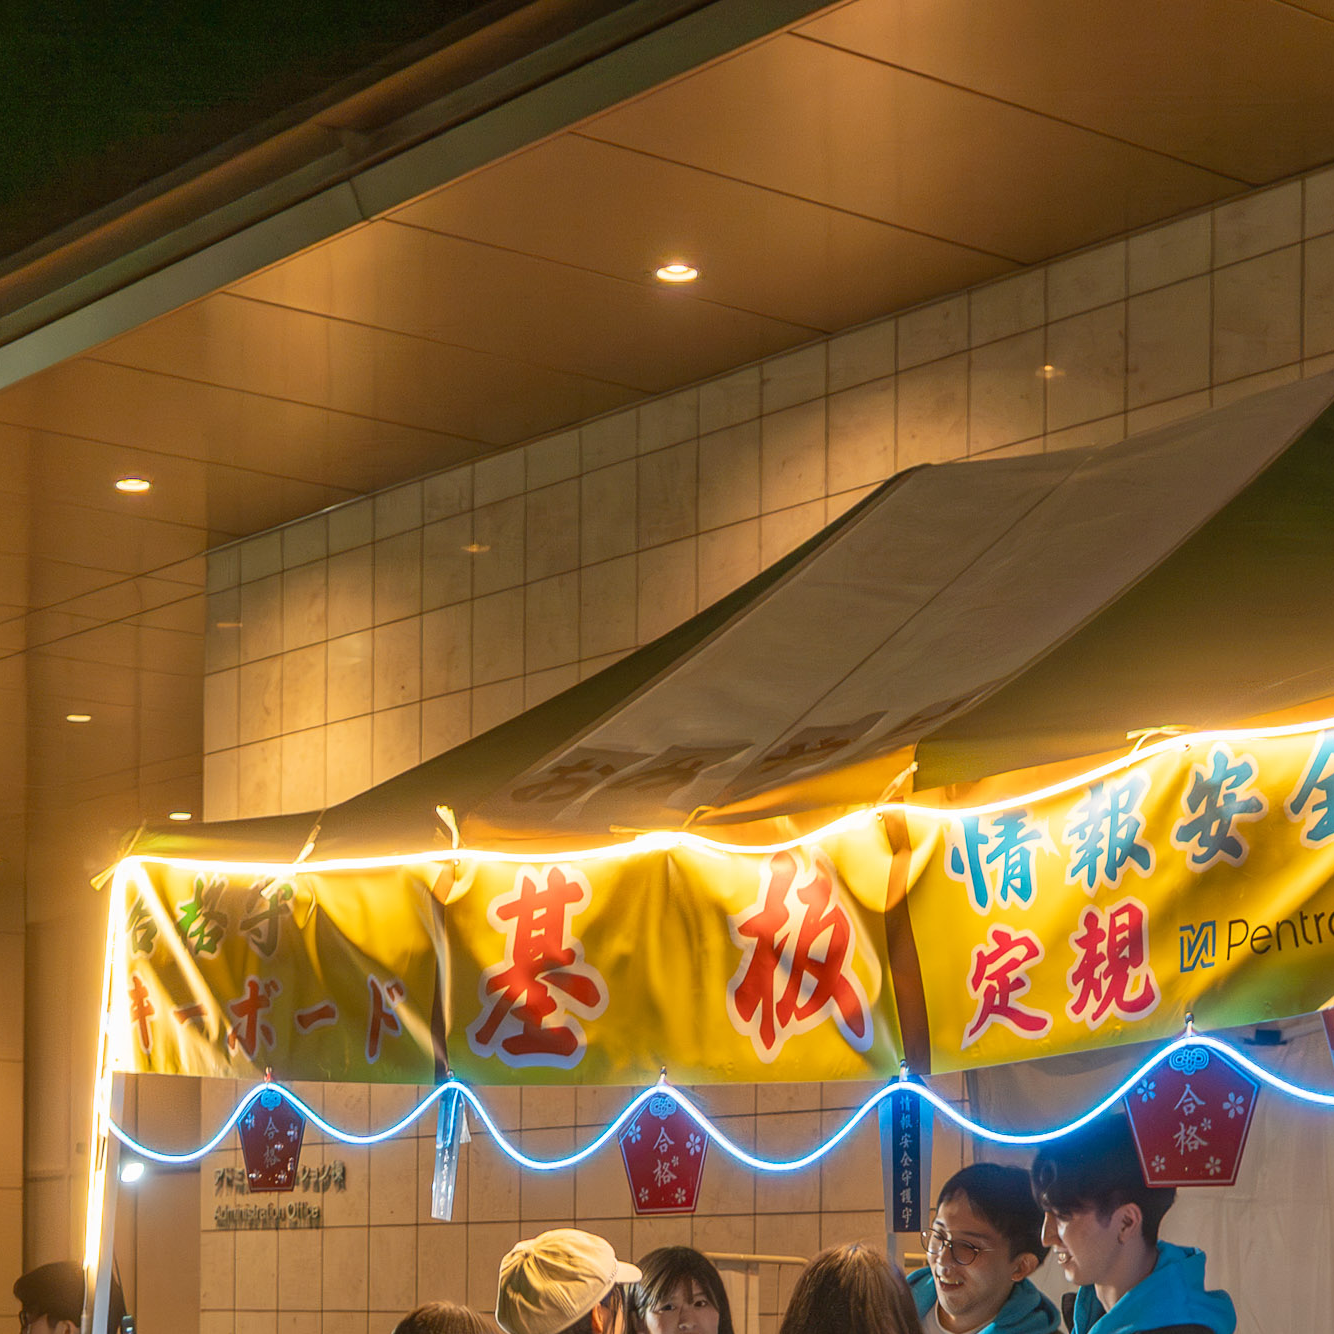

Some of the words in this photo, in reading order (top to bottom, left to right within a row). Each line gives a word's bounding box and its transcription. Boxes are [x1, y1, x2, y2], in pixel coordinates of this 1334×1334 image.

[474, 850, 866, 1058] 基板
[968, 902, 1157, 1040] 定規
[129, 972, 406, 1062] キーボード
[651, 1126, 679, 1188] 合格
[1172, 1083, 1210, 1156] 合格
